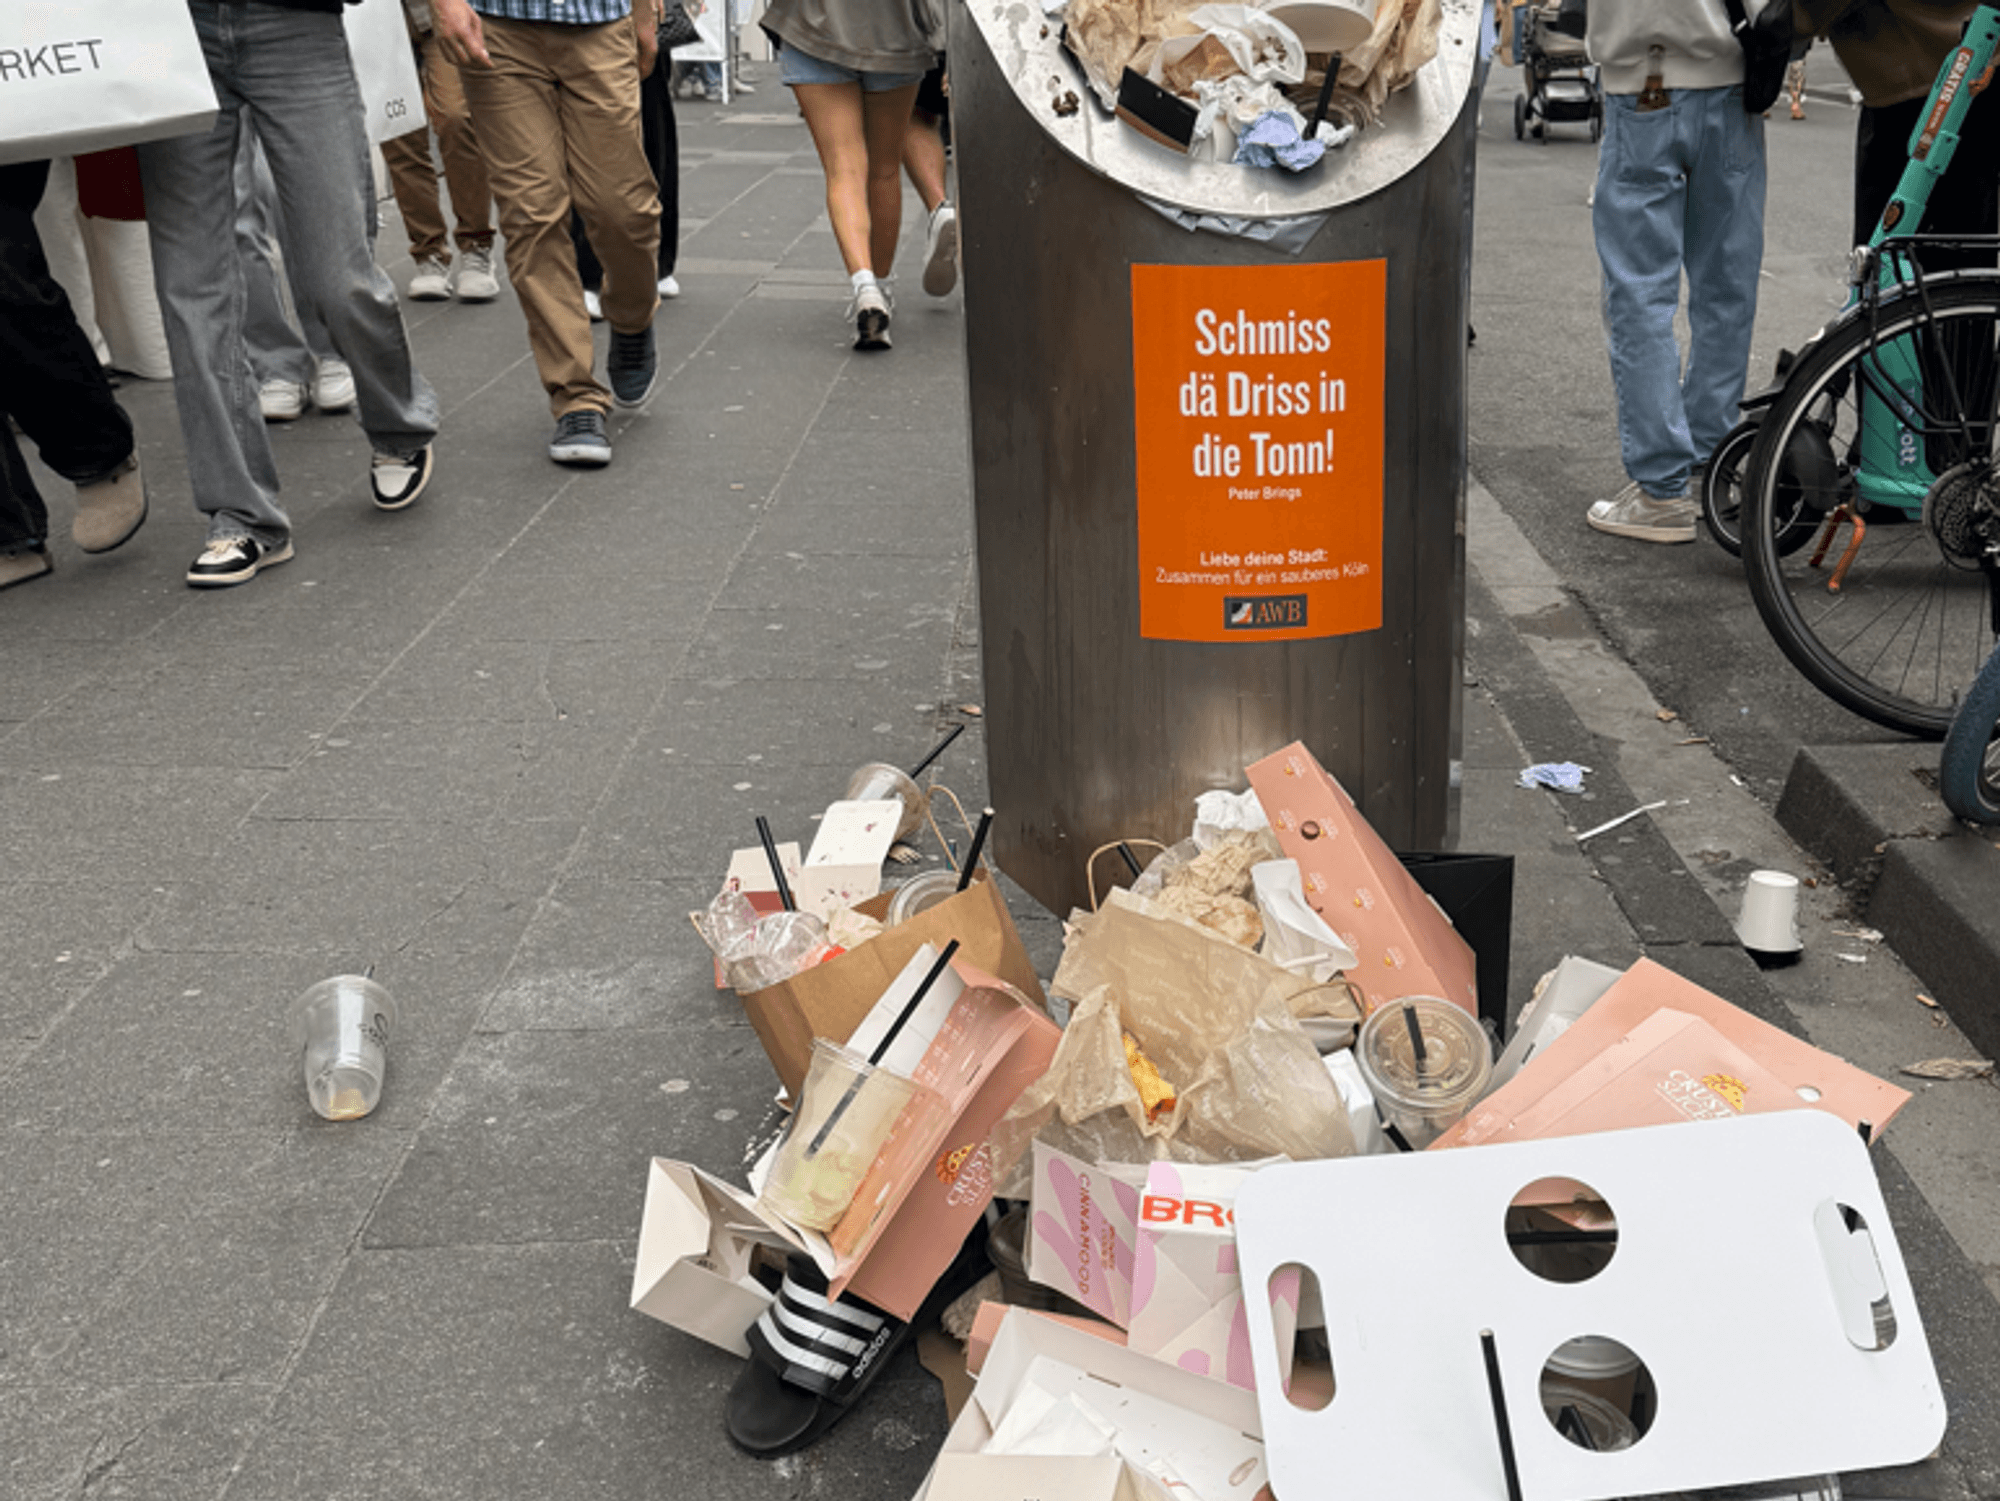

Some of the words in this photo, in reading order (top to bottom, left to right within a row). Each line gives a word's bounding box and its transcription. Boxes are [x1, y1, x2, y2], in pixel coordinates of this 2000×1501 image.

[385, 98, 406, 118] COS
[1195, 308, 1331, 356] Schmiss
[1179, 371, 1217, 417] dä
[1228, 371, 1310, 416] Driss
[1319, 370, 1345, 413] in
[1193, 432, 1241, 478] die
[1249, 428, 1334, 477] Tonn!
[1228, 486, 1260, 500] Peter
[1262, 486, 1302, 501] Brings
[1155, 566, 1231, 585] Zusammen
[1233, 569, 1253, 585] für
[1256, 572, 1276, 585] ein
[1280, 567, 1340, 583] sauberes
[1342, 562, 1370, 578] Köln
[1200, 551, 1240, 566] Liebe
[1244, 551, 1285, 566] deine
[1288, 548, 1328, 564] Stadt:
[1255, 600, 1302, 623] AWB
[1669, 1069, 1734, 1118] CRUST
[1078, 1172, 1091, 1295] CINNAMOOD
[852, 1326, 892, 1379] adidas
